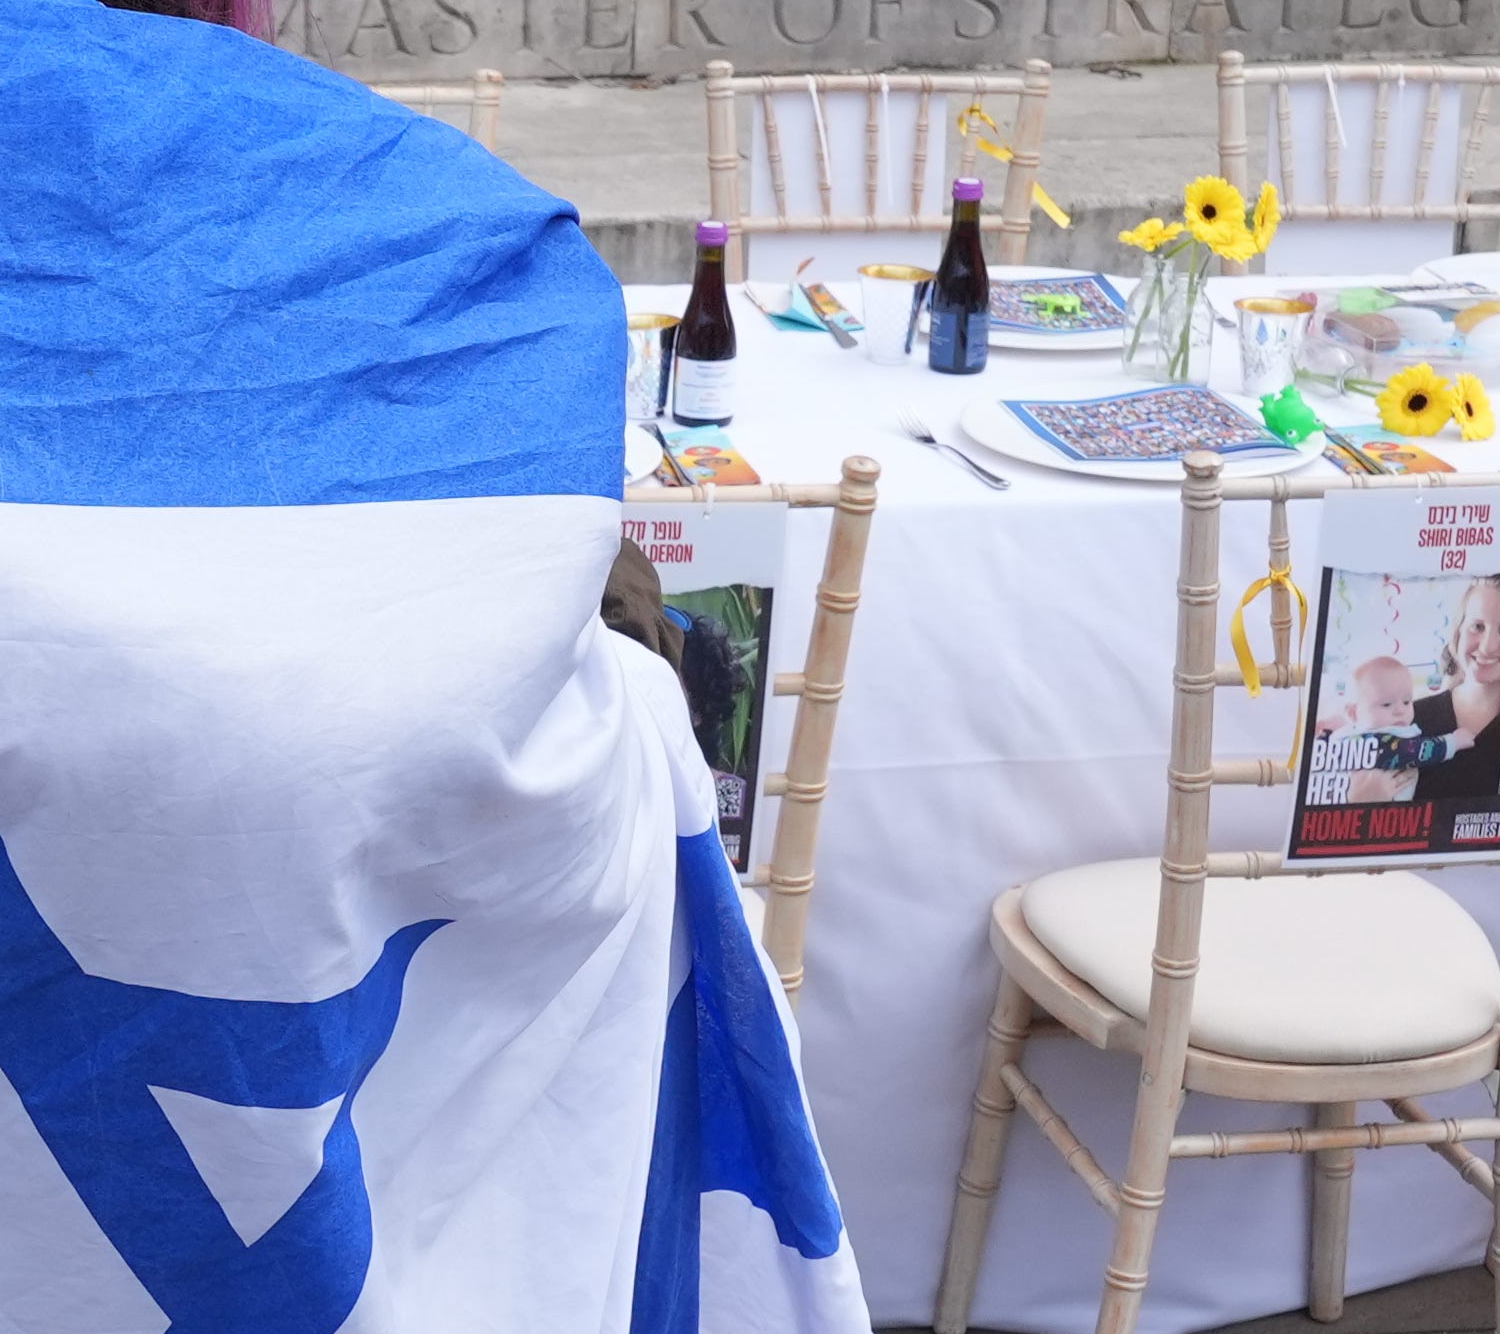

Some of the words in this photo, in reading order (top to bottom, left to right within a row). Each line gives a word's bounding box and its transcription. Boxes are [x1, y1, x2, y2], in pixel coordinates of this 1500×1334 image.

[1428, 505, 1457, 525] ביבס
[1462, 504, 1491, 524] שירי
[651, 520, 682, 541] עופר
[1418, 527, 1453, 547] SHIRI
[1455, 526, 1495, 546] BIBAS
[1440, 548, 1466, 571] (32)
[1311, 738, 1378, 772] BRING
[1305, 770, 1350, 806] HER
[1301, 809, 1364, 842] HOME
[1453, 822, 1497, 839] FAMILIES
